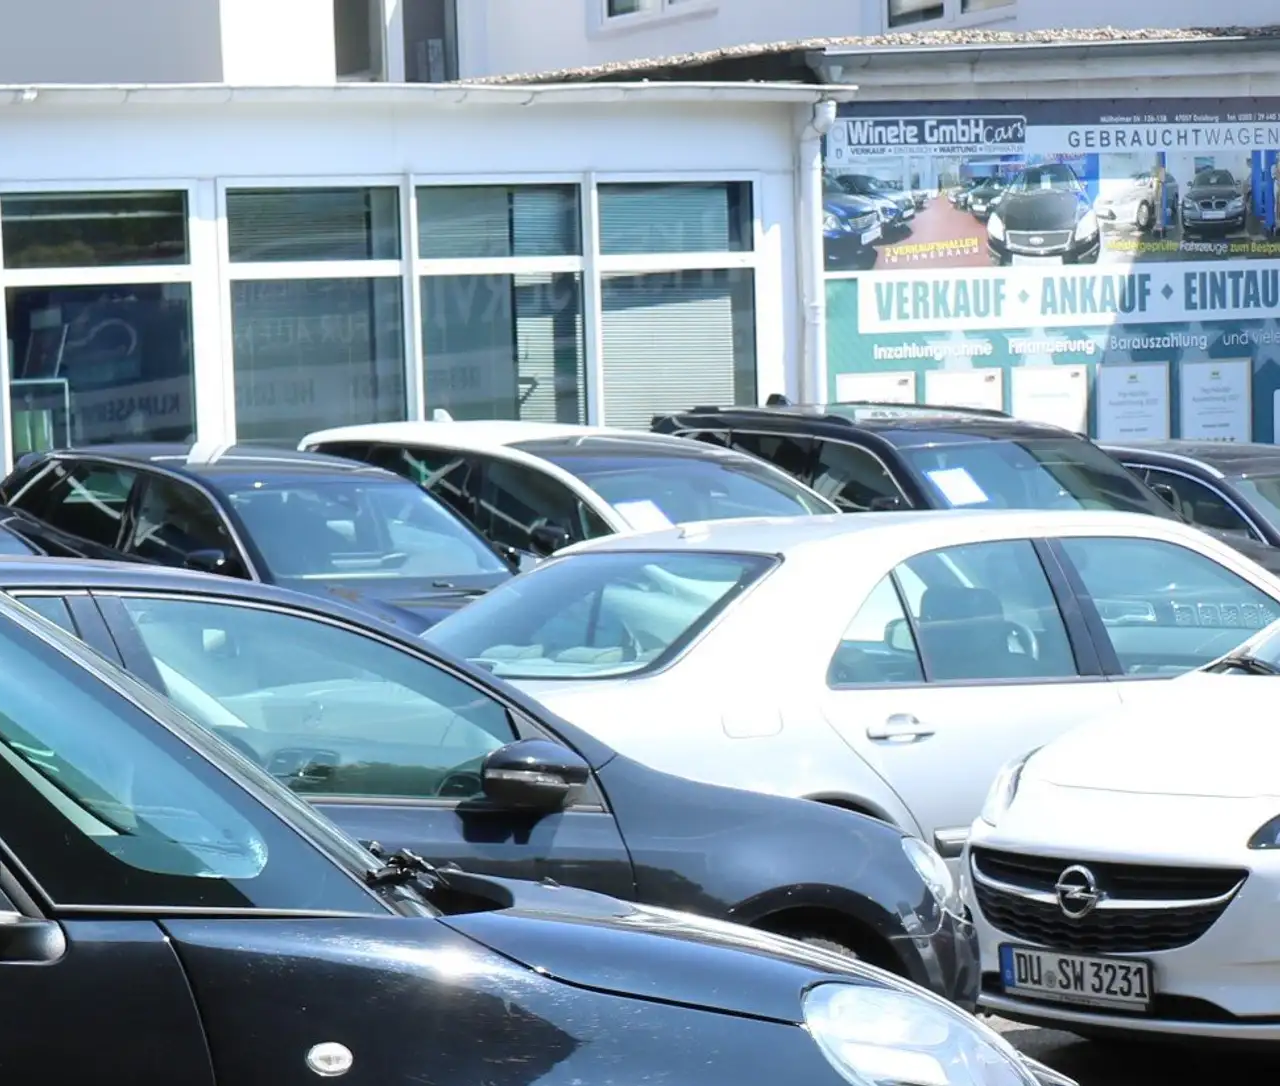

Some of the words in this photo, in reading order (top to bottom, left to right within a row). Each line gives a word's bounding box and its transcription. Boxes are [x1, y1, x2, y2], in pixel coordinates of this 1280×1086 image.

[847, 120, 919, 144] Winete
[924, 118, 984, 143] GmbH
[1068, 128, 1279, 147] GEBRAUCHTWAGEN
[874, 278, 1006, 321] VERKAUF
[1040, 273, 1151, 316] ANKAUF
[873, 338, 993, 360] Inzahlungnahme
[1111, 332, 1208, 351] Barauszahlung
[1223, 330, 1248, 346] und
[1015, 952, 1042, 985] DU
[1058, 958, 1084, 991] SW
[1090, 961, 1147, 998] 3231
